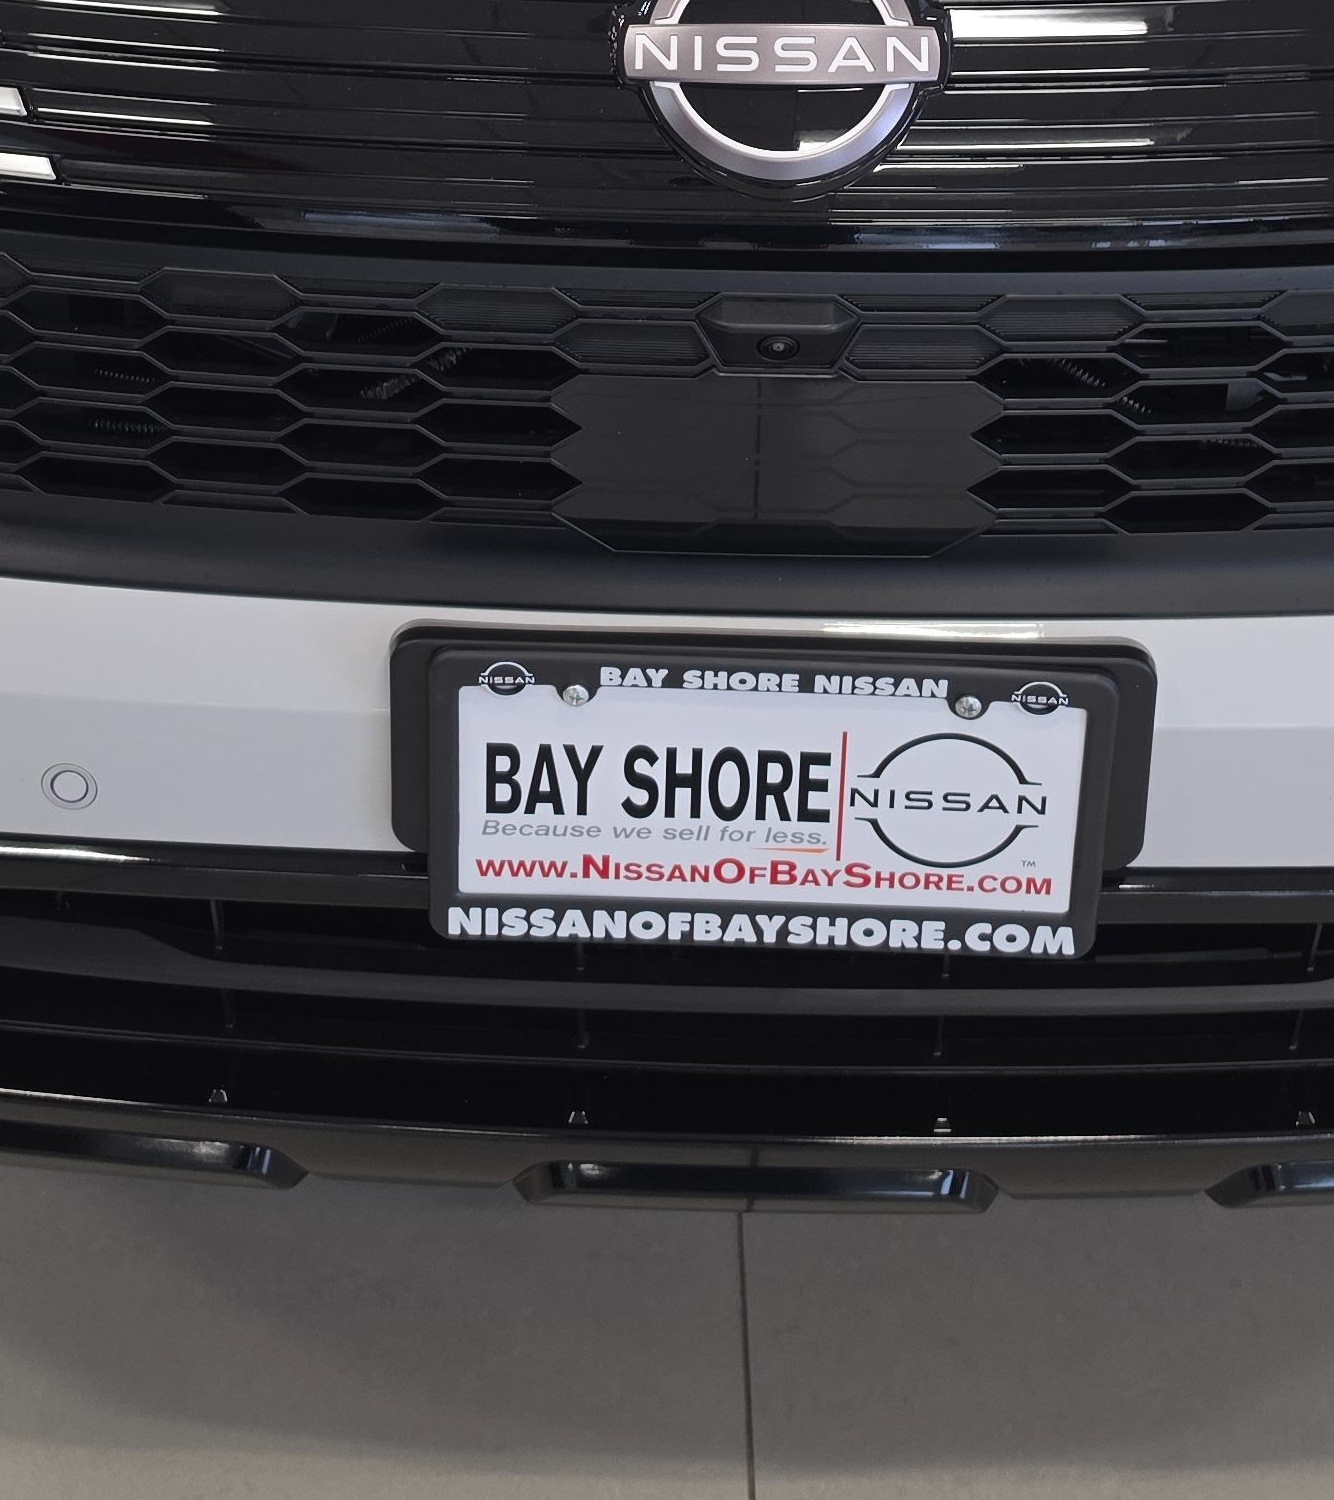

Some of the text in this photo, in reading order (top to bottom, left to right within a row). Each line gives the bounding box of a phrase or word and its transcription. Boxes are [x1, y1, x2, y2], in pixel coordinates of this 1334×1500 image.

[634, 33, 929, 73] NISSAN
[478, 675, 535, 685] NISSAN
[600, 666, 949, 698] BAY SHORE NISSAN
[1011, 693, 1069, 706] NISSAN
[485, 742, 832, 823] BAY SHORE
[849, 787, 1048, 816] NISSAN
[481, 819, 827, 845] Because we sell for less.
[448, 906, 1075, 956] NISSANOFBAYSHORE.COM
